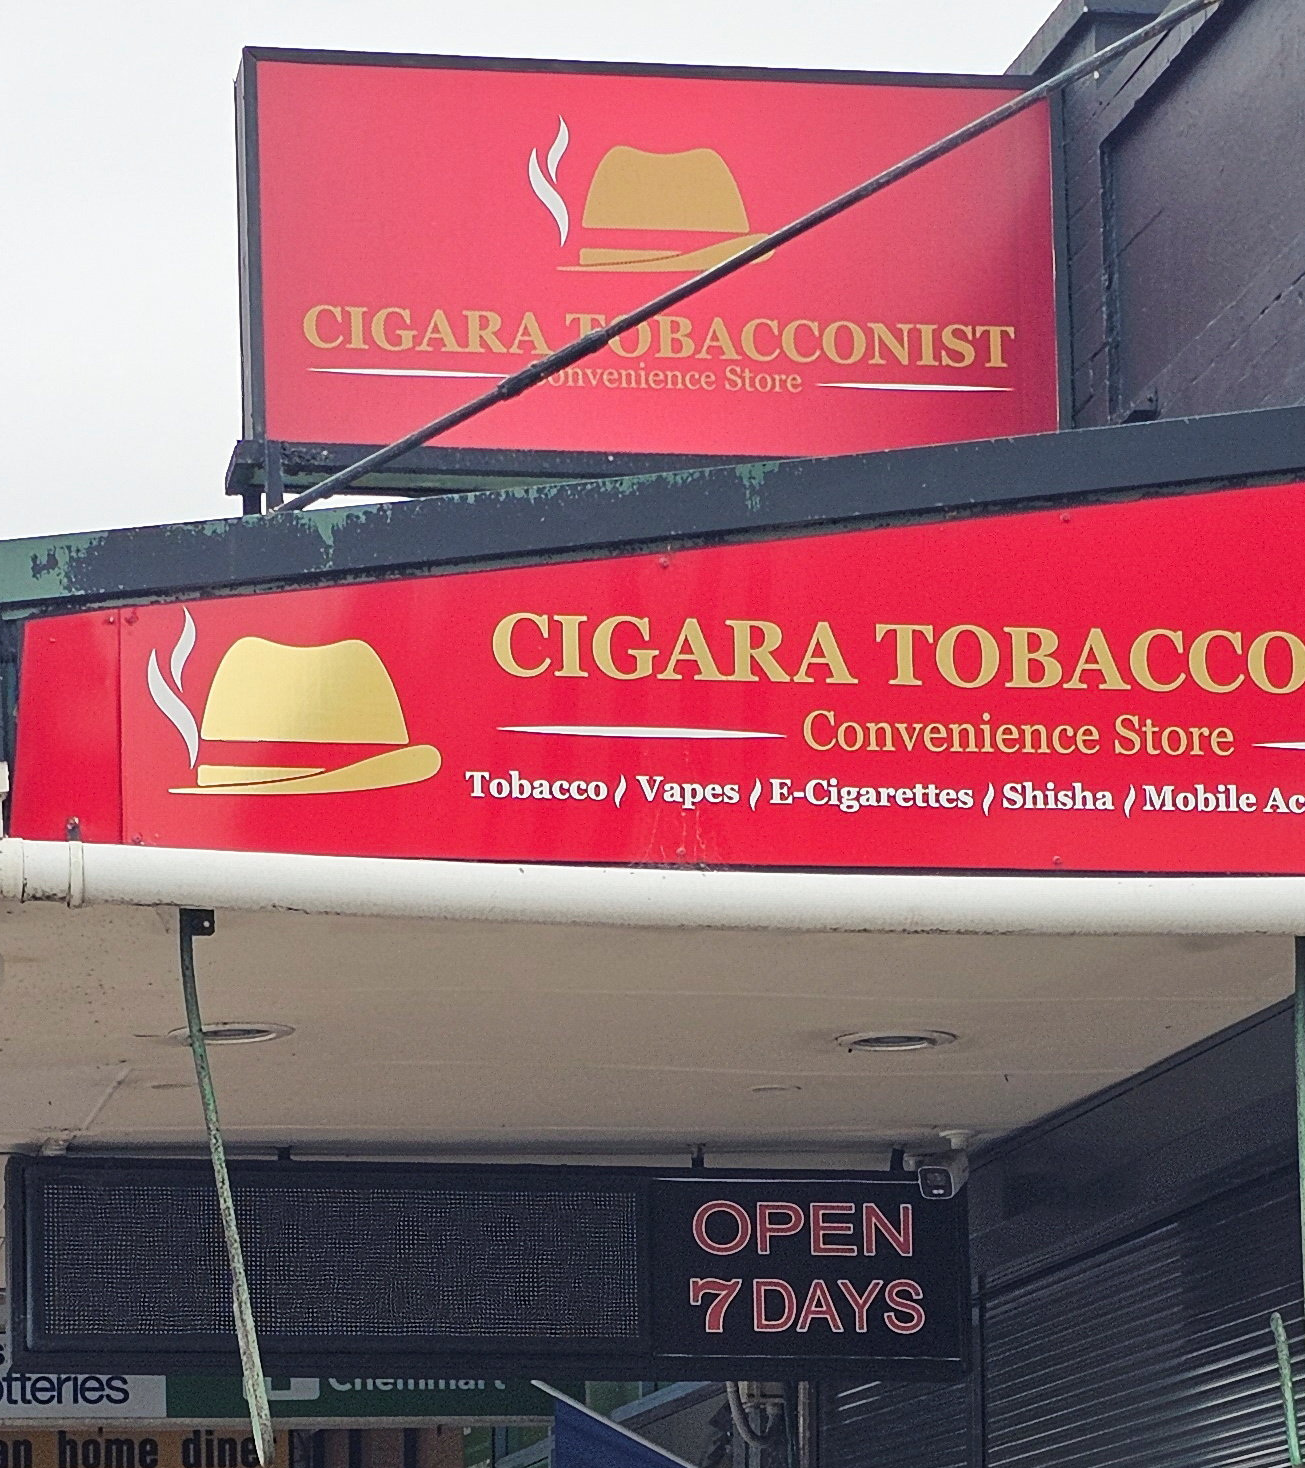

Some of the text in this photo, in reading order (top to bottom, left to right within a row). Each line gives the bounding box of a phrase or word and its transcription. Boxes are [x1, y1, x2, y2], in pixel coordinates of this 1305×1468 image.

[302, 303, 1016, 369] CIGARA TOBACCONIST
[724, 364, 803, 393] Store
[492, 611, 858, 687] CIGARA
[802, 709, 1236, 758] Convenience Store
[465, 771, 608, 804] Tobacco
[635, 777, 740, 813] Vapes
[769, 778, 974, 817] E-Cigarettes
[1002, 782, 1114, 814] Shisha
[1142, 785, 1257, 815] Mobile
[692, 1200, 913, 1257] OPEN
[690, 1278, 926, 1334] 7 DAYS
